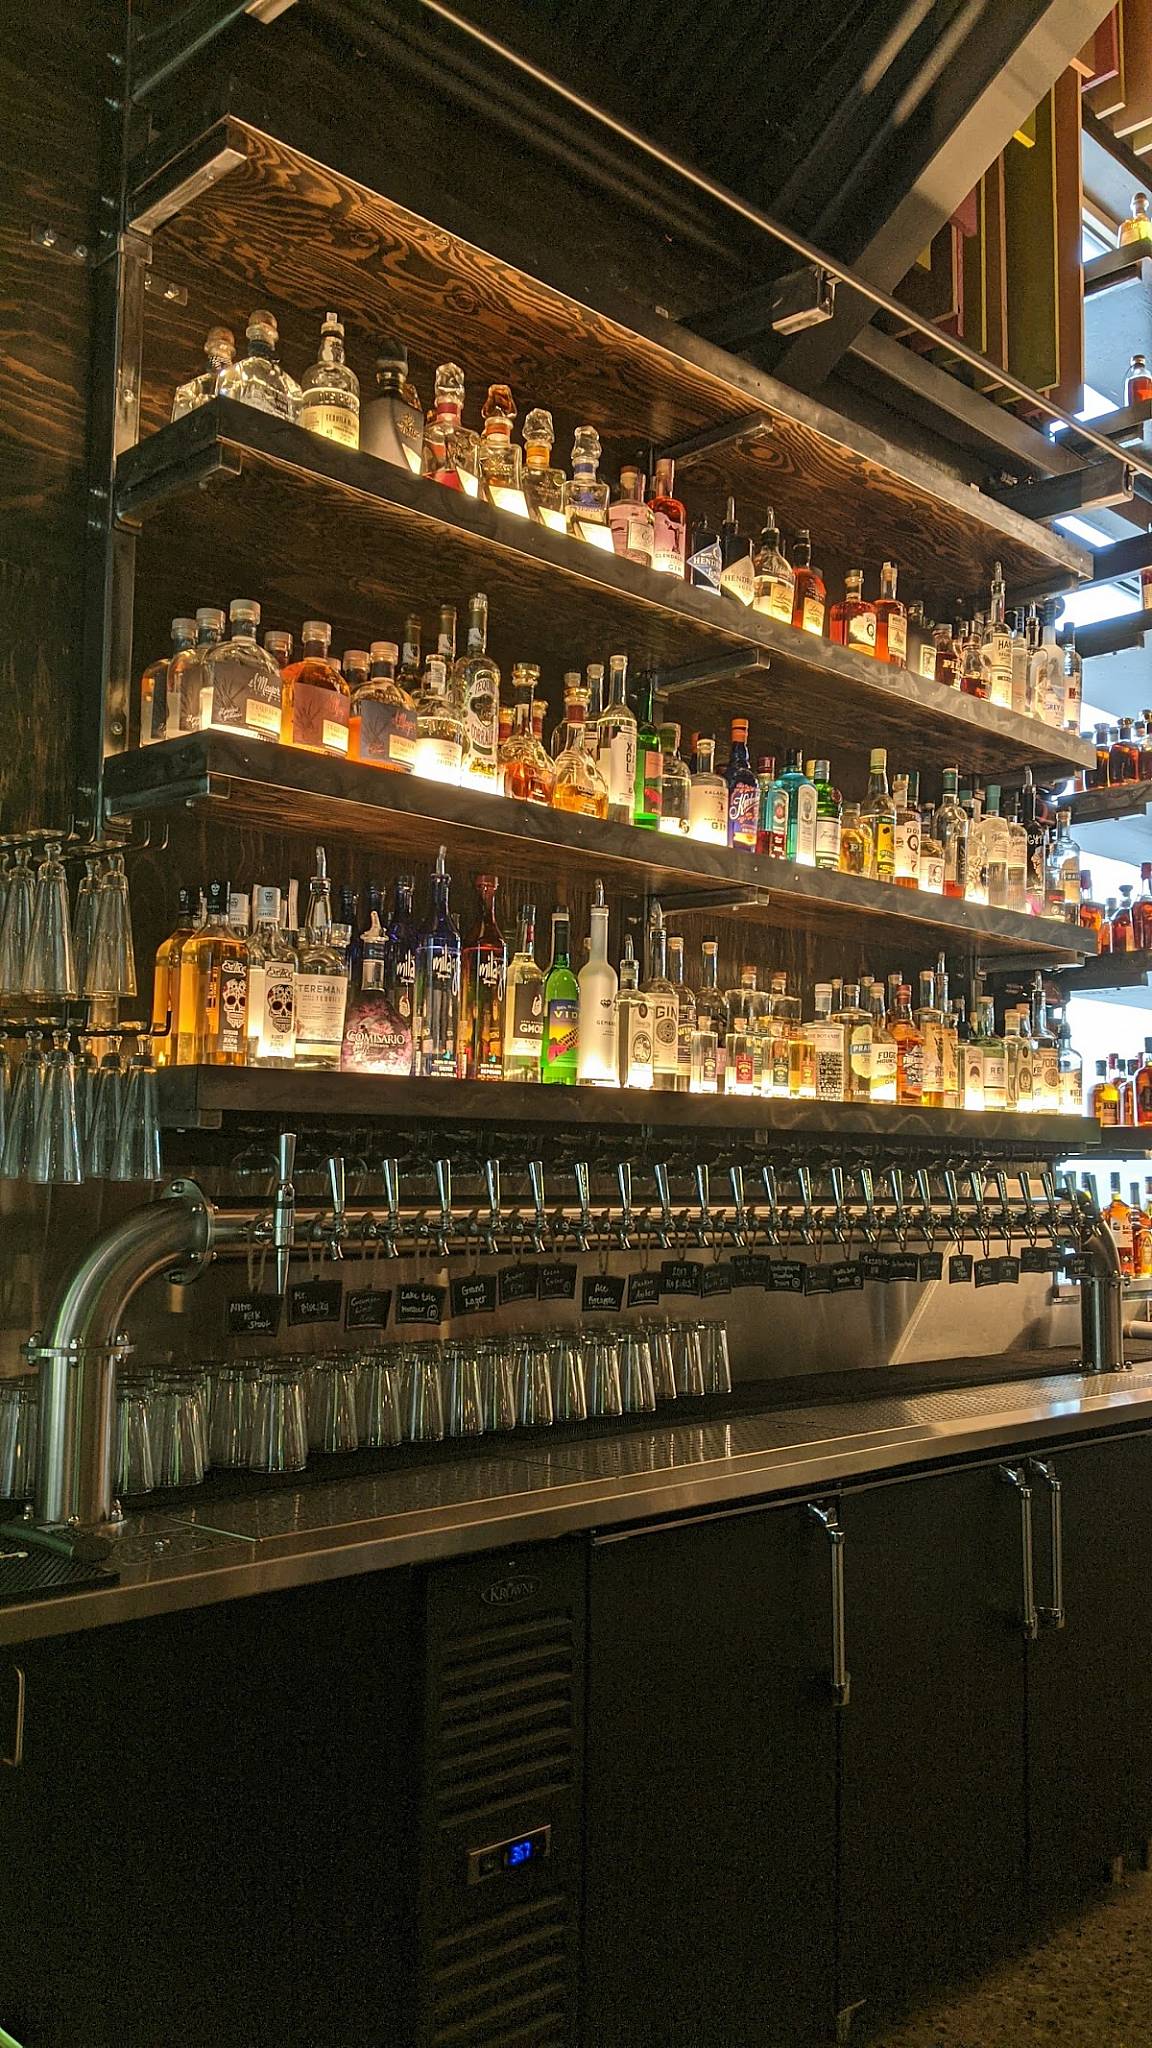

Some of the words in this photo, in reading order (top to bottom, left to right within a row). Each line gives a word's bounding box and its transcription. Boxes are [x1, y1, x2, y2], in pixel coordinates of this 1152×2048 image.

[907, 835, 919, 854] Q
[656, 1005, 678, 1022] GIN
[346, 1029, 405, 1045] COMISARIO
